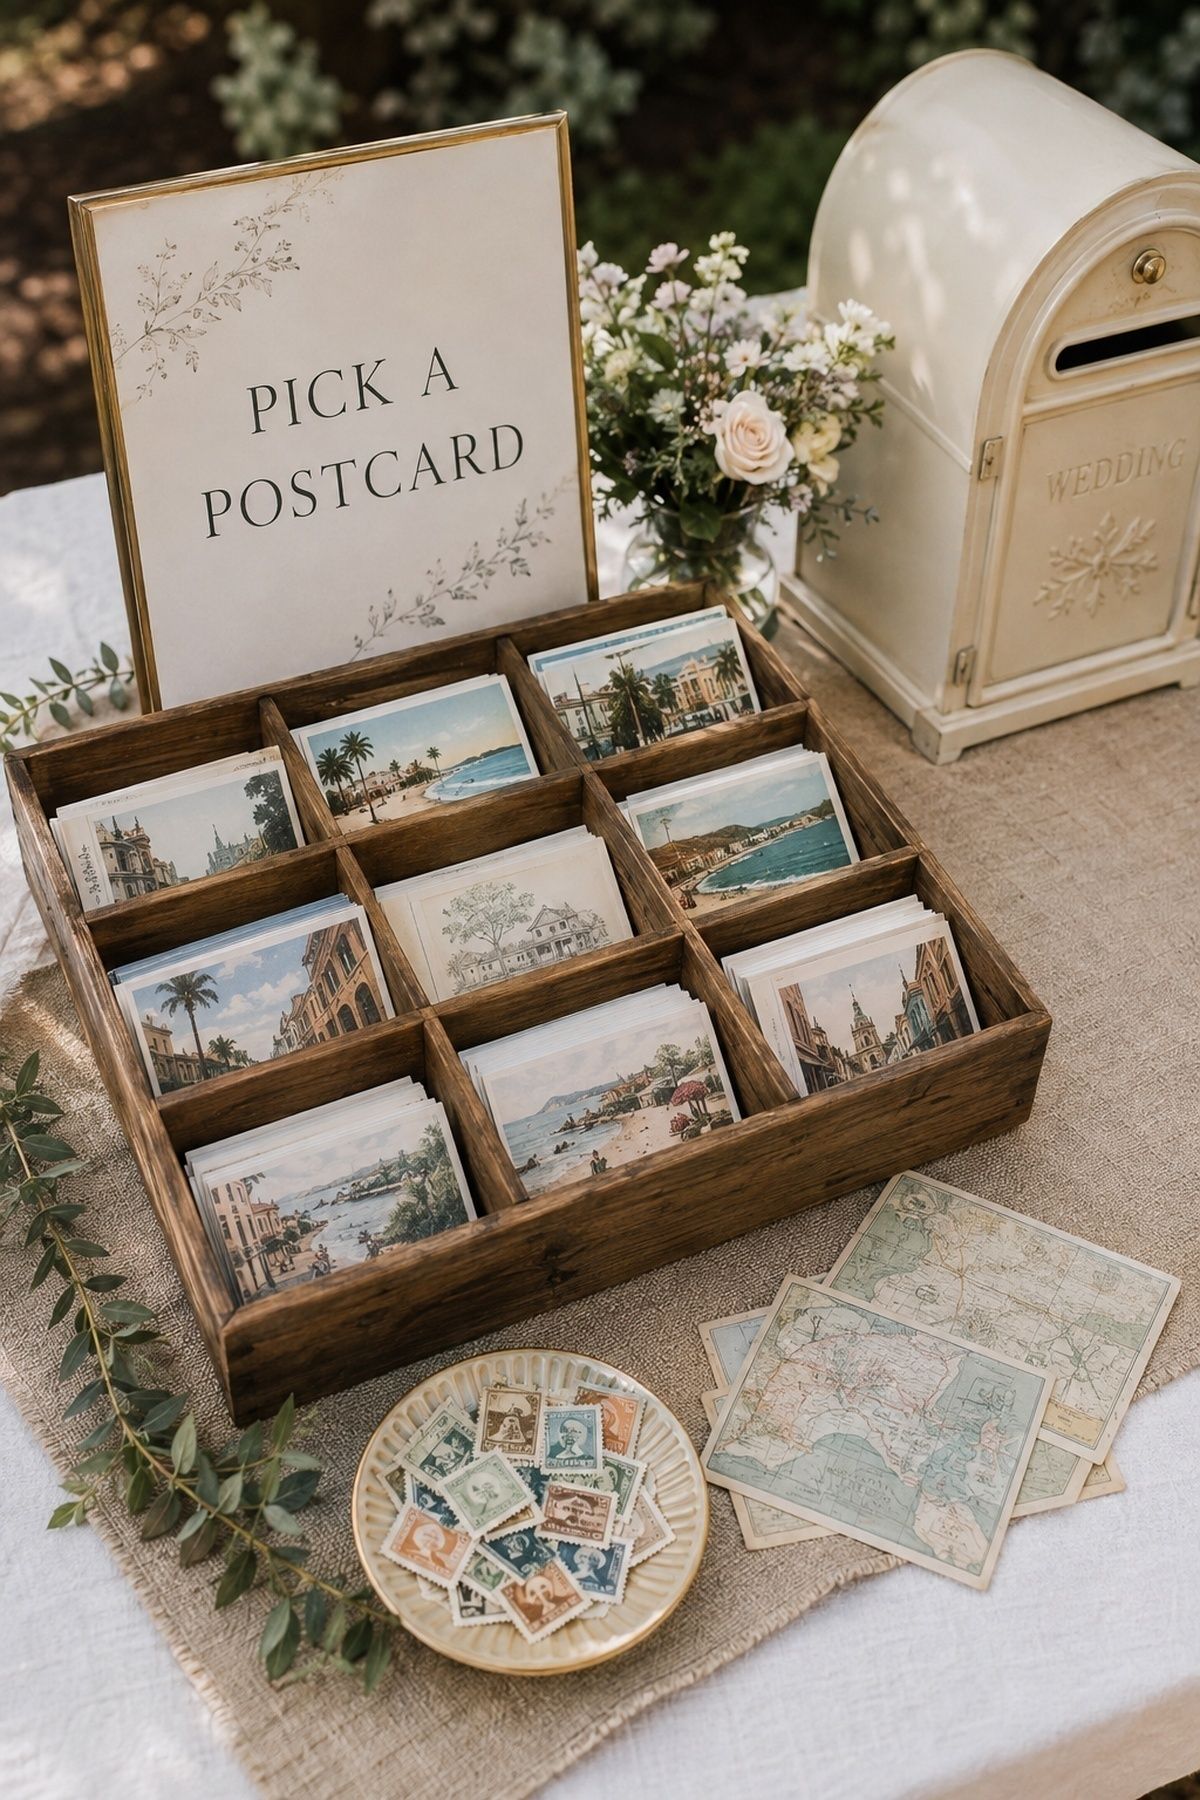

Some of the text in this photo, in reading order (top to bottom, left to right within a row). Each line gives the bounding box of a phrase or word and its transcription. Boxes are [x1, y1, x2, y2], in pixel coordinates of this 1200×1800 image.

[246, 346, 459, 435] PICK A
[201, 423, 524, 539] POSTCARD
[1046, 438, 1187, 502] WEDDING
